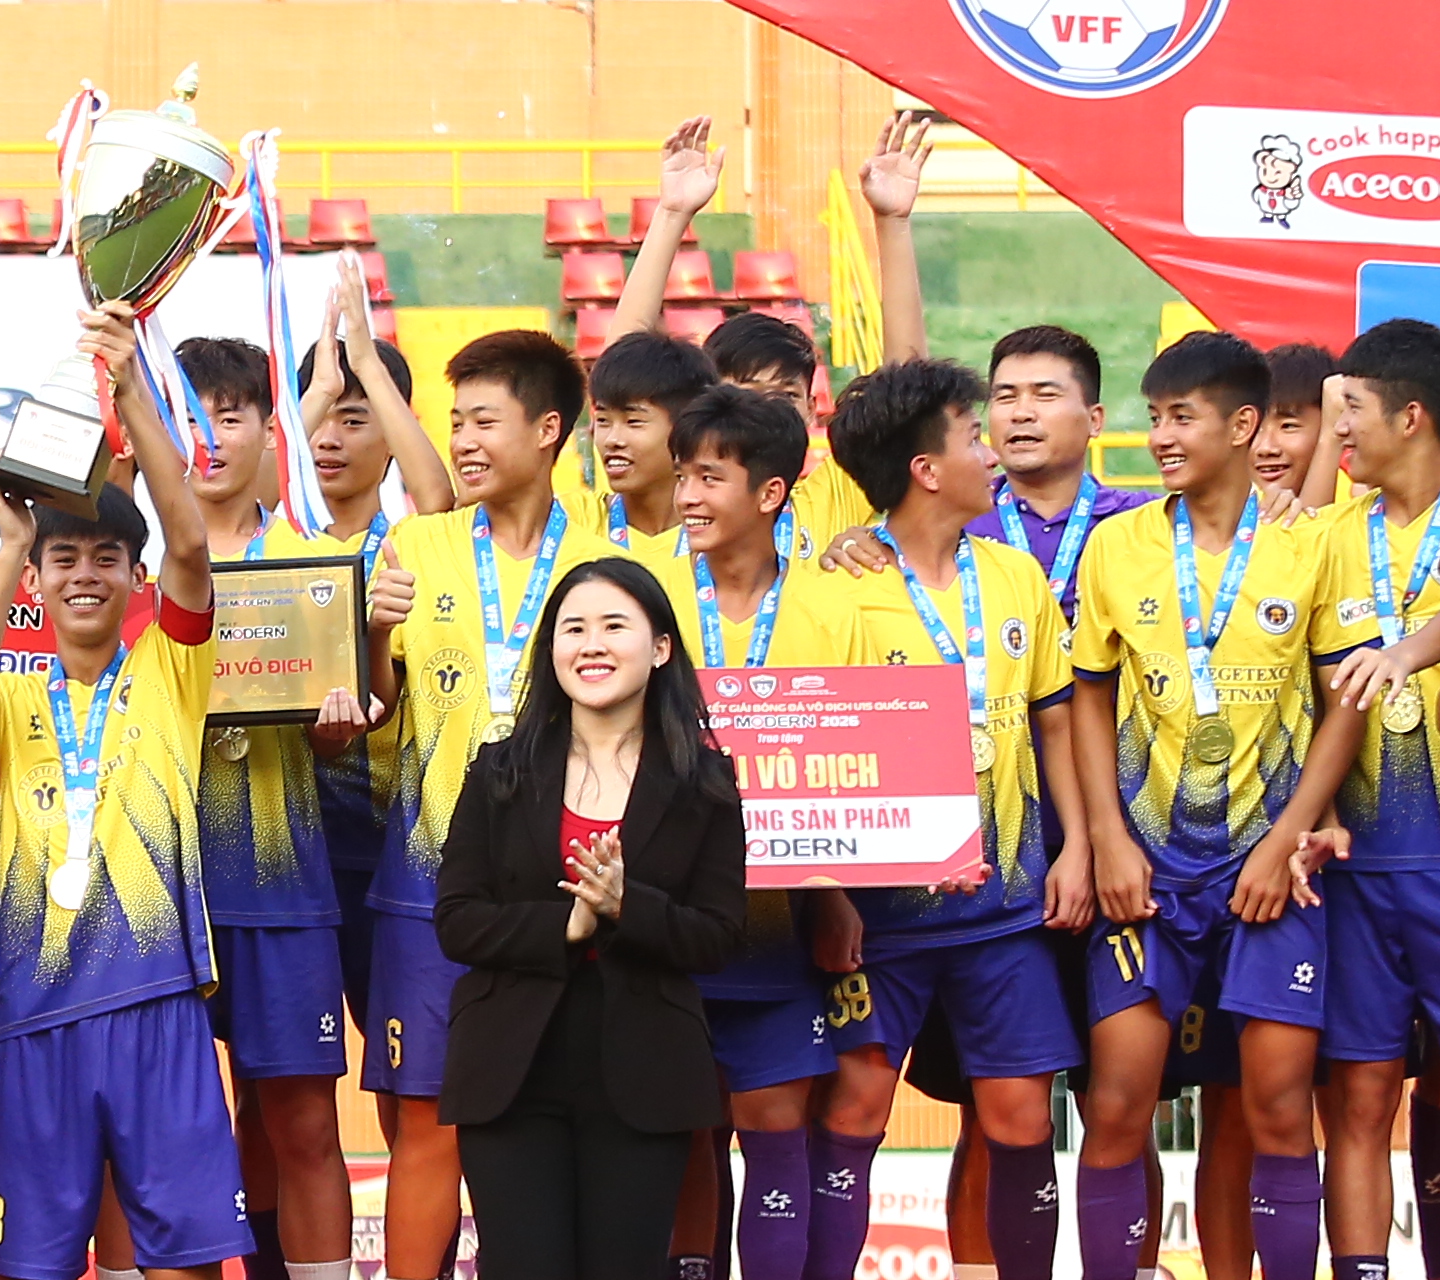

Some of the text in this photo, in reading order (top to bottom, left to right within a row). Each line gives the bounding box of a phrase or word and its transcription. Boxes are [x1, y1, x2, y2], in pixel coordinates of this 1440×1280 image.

[1051, 14, 1122, 44] VFF
[1307, 126, 1369, 157] Cook
[1075, 496, 1093, 518] VFF
[540, 535, 557, 559] VFF
[1375, 578, 1389, 603] VFF
[484, 603, 499, 630] VFF
[219, 626, 286, 641] MODERN
[932, 631, 957, 657] VFF
[235, 656, 263, 675] VÔ
[267, 658, 313, 677] ĐỊCH
[908, 700, 929, 711] GIA
[734, 715, 817, 729] MODERN
[819, 716, 860, 728] 2026
[755, 747, 798, 790] VÔ
[804, 752, 880, 796] ĐỊCH
[791, 802, 837, 831] SẢN
[845, 800, 911, 830] PHẨM
[745, 837, 858, 858] ODERN
[1106, 926, 1145, 982] 11
[826, 972, 873, 1028] 38
[387, 1018, 402, 1069] 6
